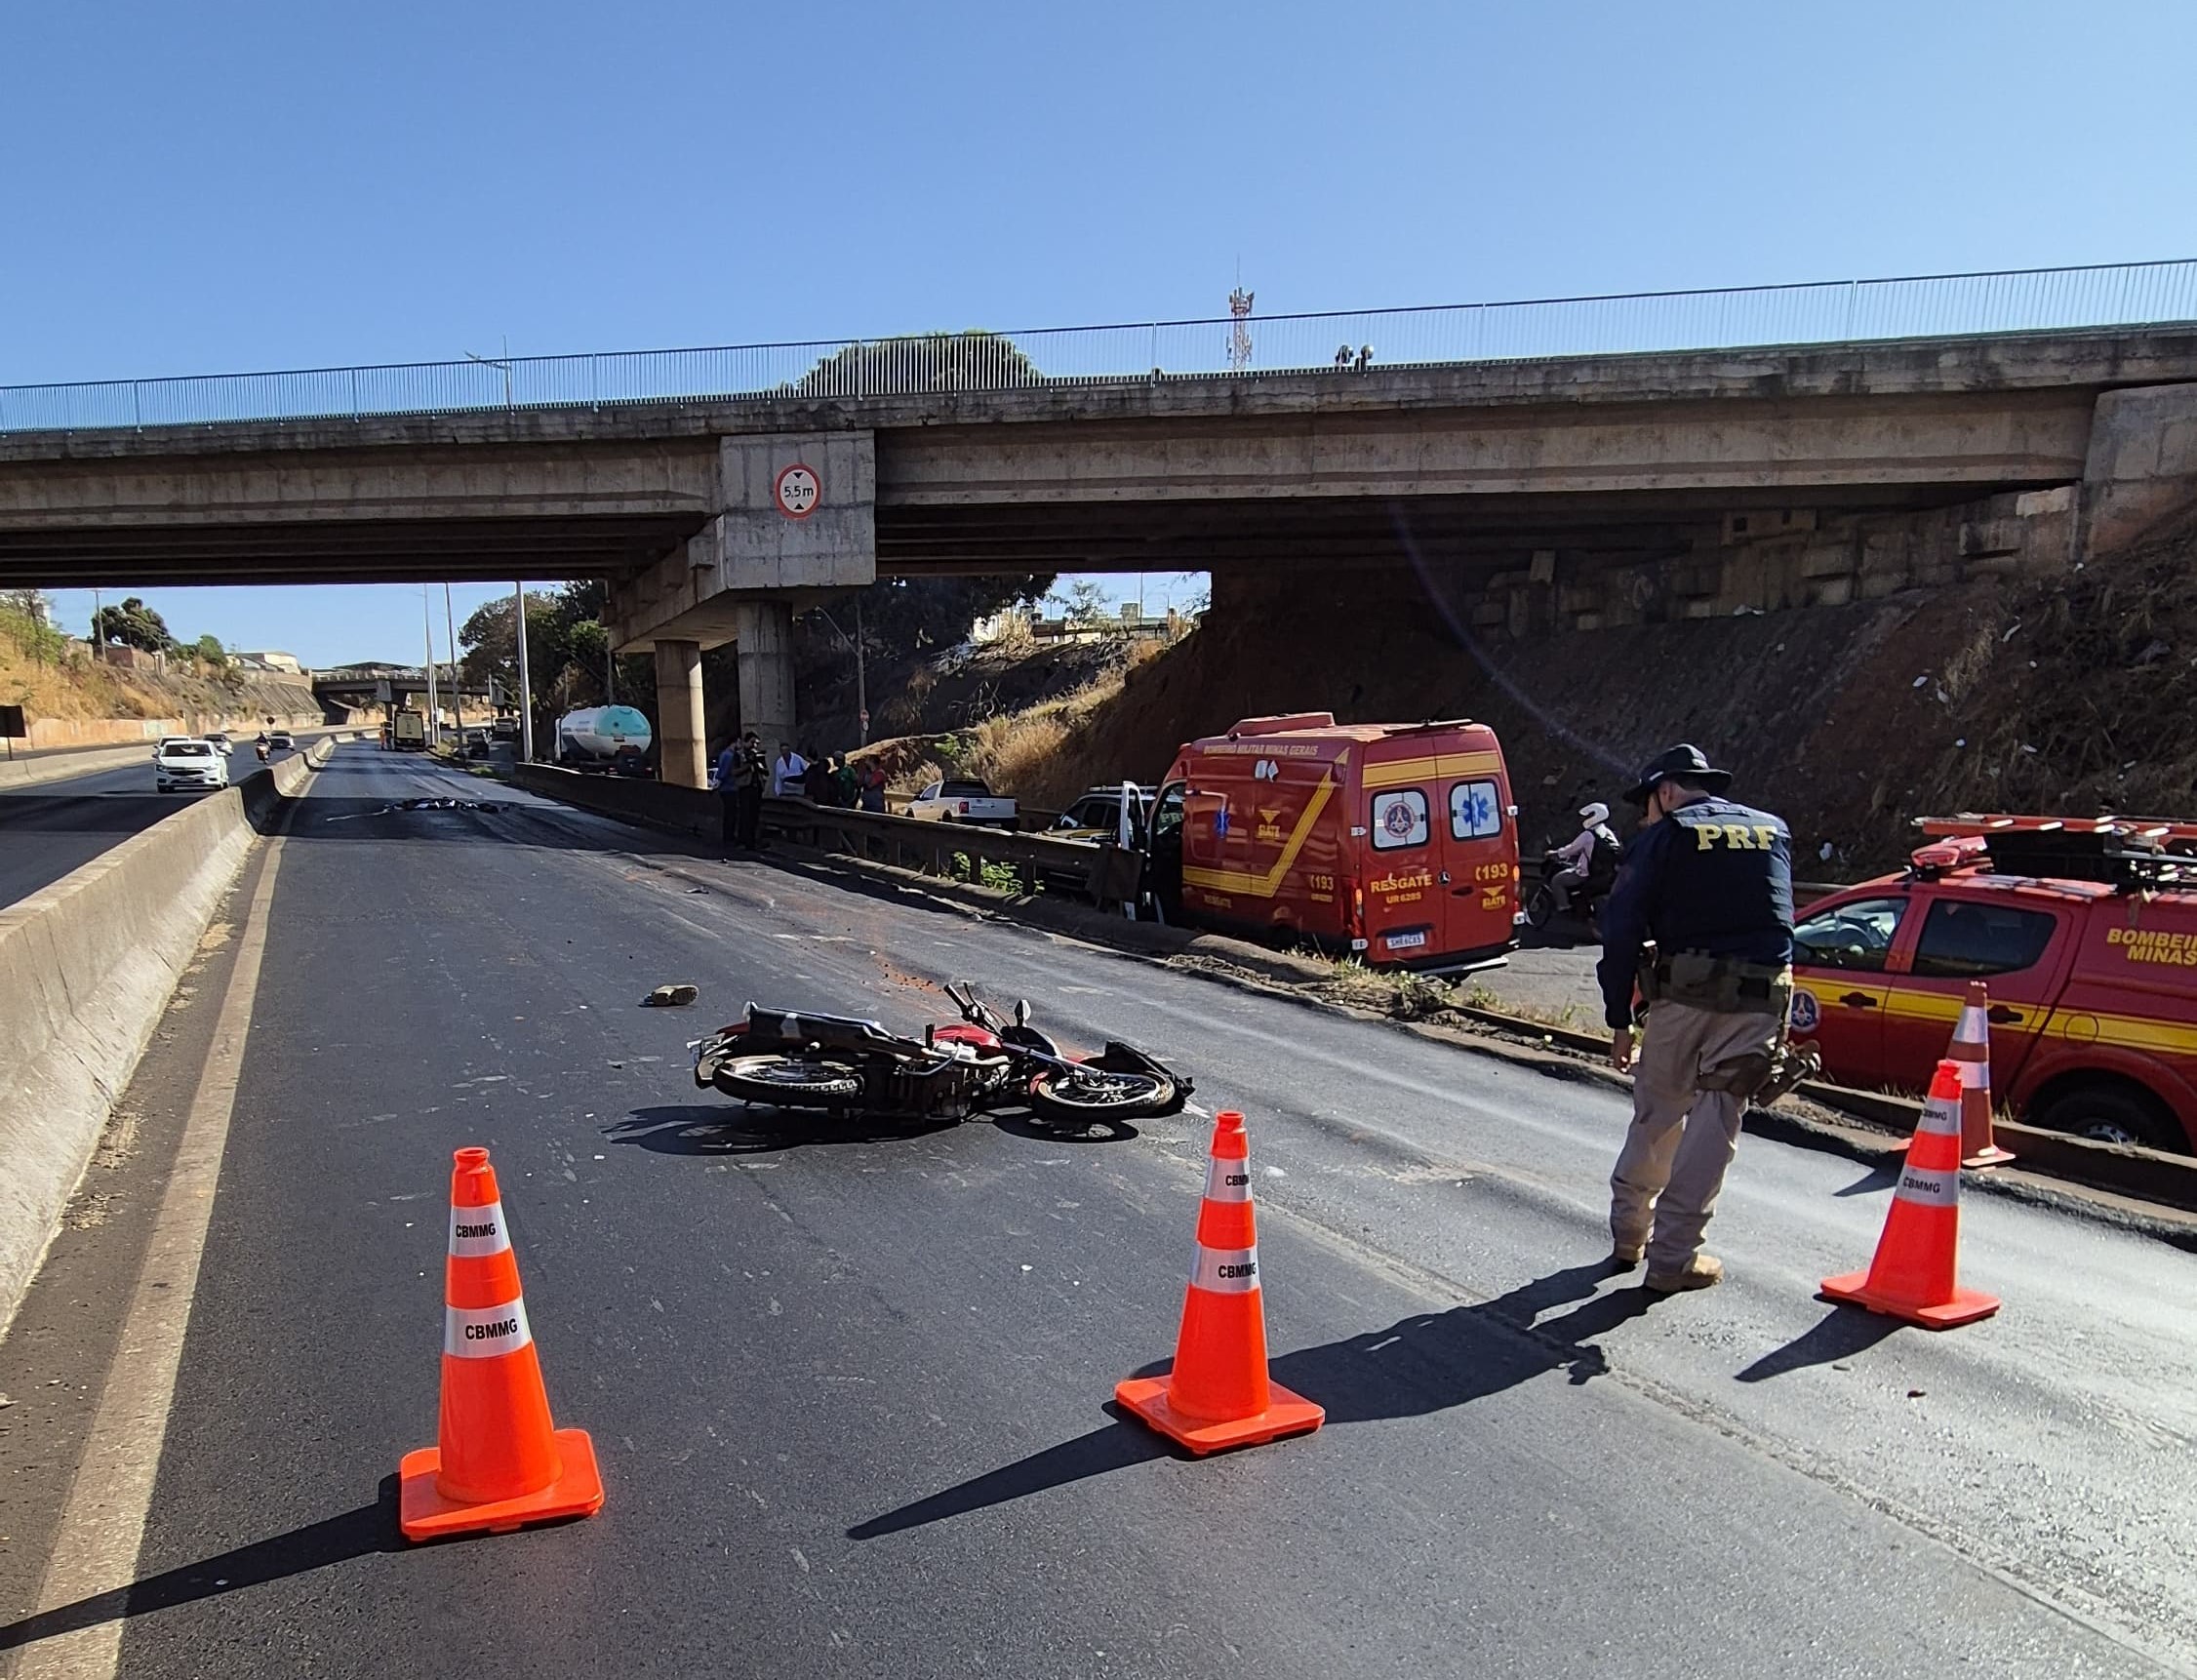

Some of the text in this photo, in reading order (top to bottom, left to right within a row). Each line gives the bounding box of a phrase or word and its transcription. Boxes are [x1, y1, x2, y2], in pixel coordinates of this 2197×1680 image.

[1289, 745, 1319, 757] GERAIS
[1694, 823, 1778, 851] PRF
[1371, 874, 1433, 894] RESGATE
[2126, 944, 2197, 966] MINAS
[1902, 1177, 1941, 1193] CBMMG
[456, 1222, 497, 1239] CBMMG
[1218, 1262, 1257, 1279] CBMMG
[465, 1318, 519, 1340] CBMMG
